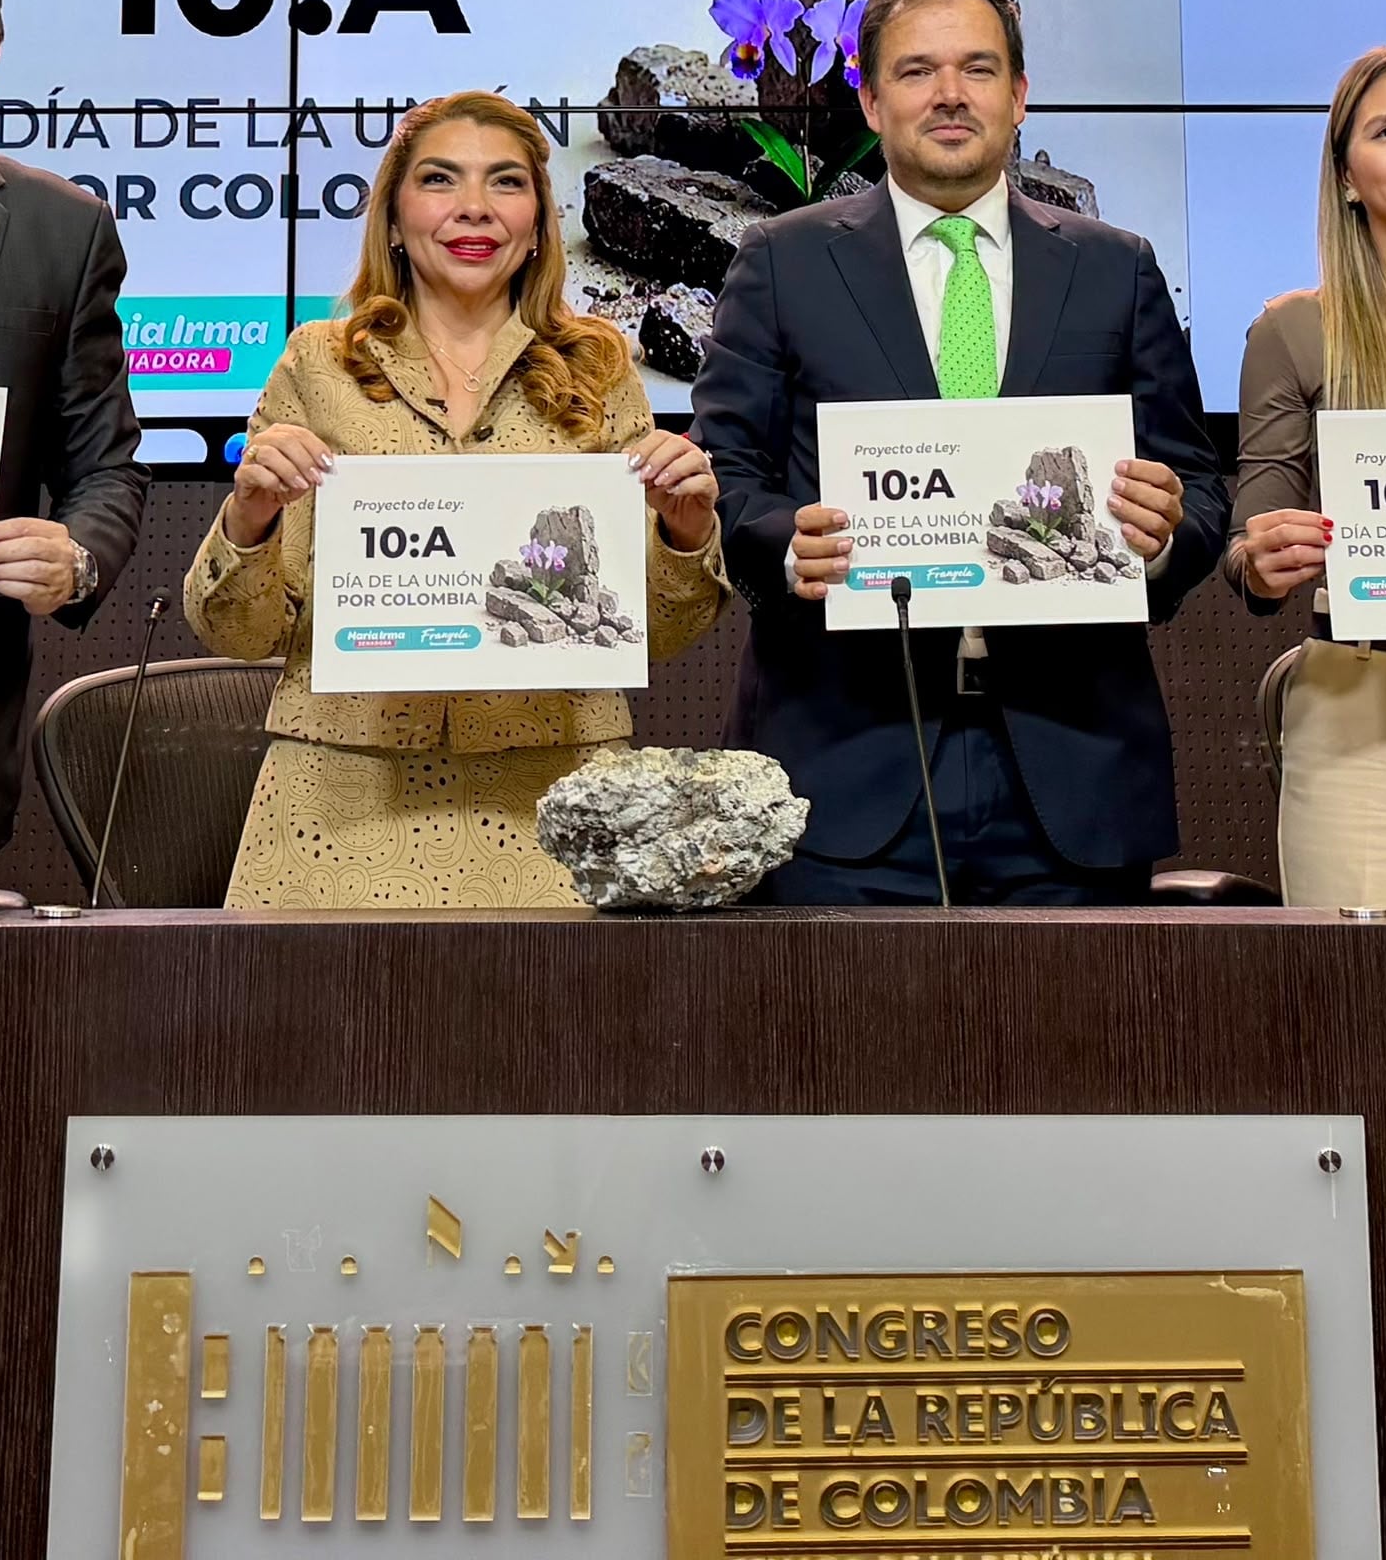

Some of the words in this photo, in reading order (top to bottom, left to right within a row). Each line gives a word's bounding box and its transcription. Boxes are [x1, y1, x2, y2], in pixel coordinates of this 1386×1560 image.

[134, 98, 221, 148] DE
[247, 97, 332, 148] LA
[171, 314, 269, 345] Irma
[854, 445, 913, 457] Proyecto
[915, 443, 932, 453] de
[934, 442, 961, 455] Ley:
[862, 468, 956, 501] 10:A
[353, 499, 415, 513] Proyecto
[417, 498, 435, 510] de
[437, 499, 464, 512] Ley:
[873, 516, 896, 529] DE
[901, 515, 922, 528] LA
[927, 511, 983, 527] UNIÓN
[1341, 523, 1372, 539] DÍA
[360, 526, 456, 558] 10:A
[1348, 544, 1385, 557] POR
[332, 572, 363, 588] DÍA
[369, 575, 392, 588] DE
[398, 574, 420, 587] LA
[425, 571, 482, 586] UNIÓN
[337, 594, 375, 607] POR
[725, 1302, 1071, 1362] CONGRESO
[725, 1387, 803, 1446] DE
[821, 1387, 898, 1445] LA
[914, 1377, 1242, 1444] REPÚBLICA
[725, 1471, 802, 1530] DE
[818, 1470, 1158, 1529] COLOMBIA
